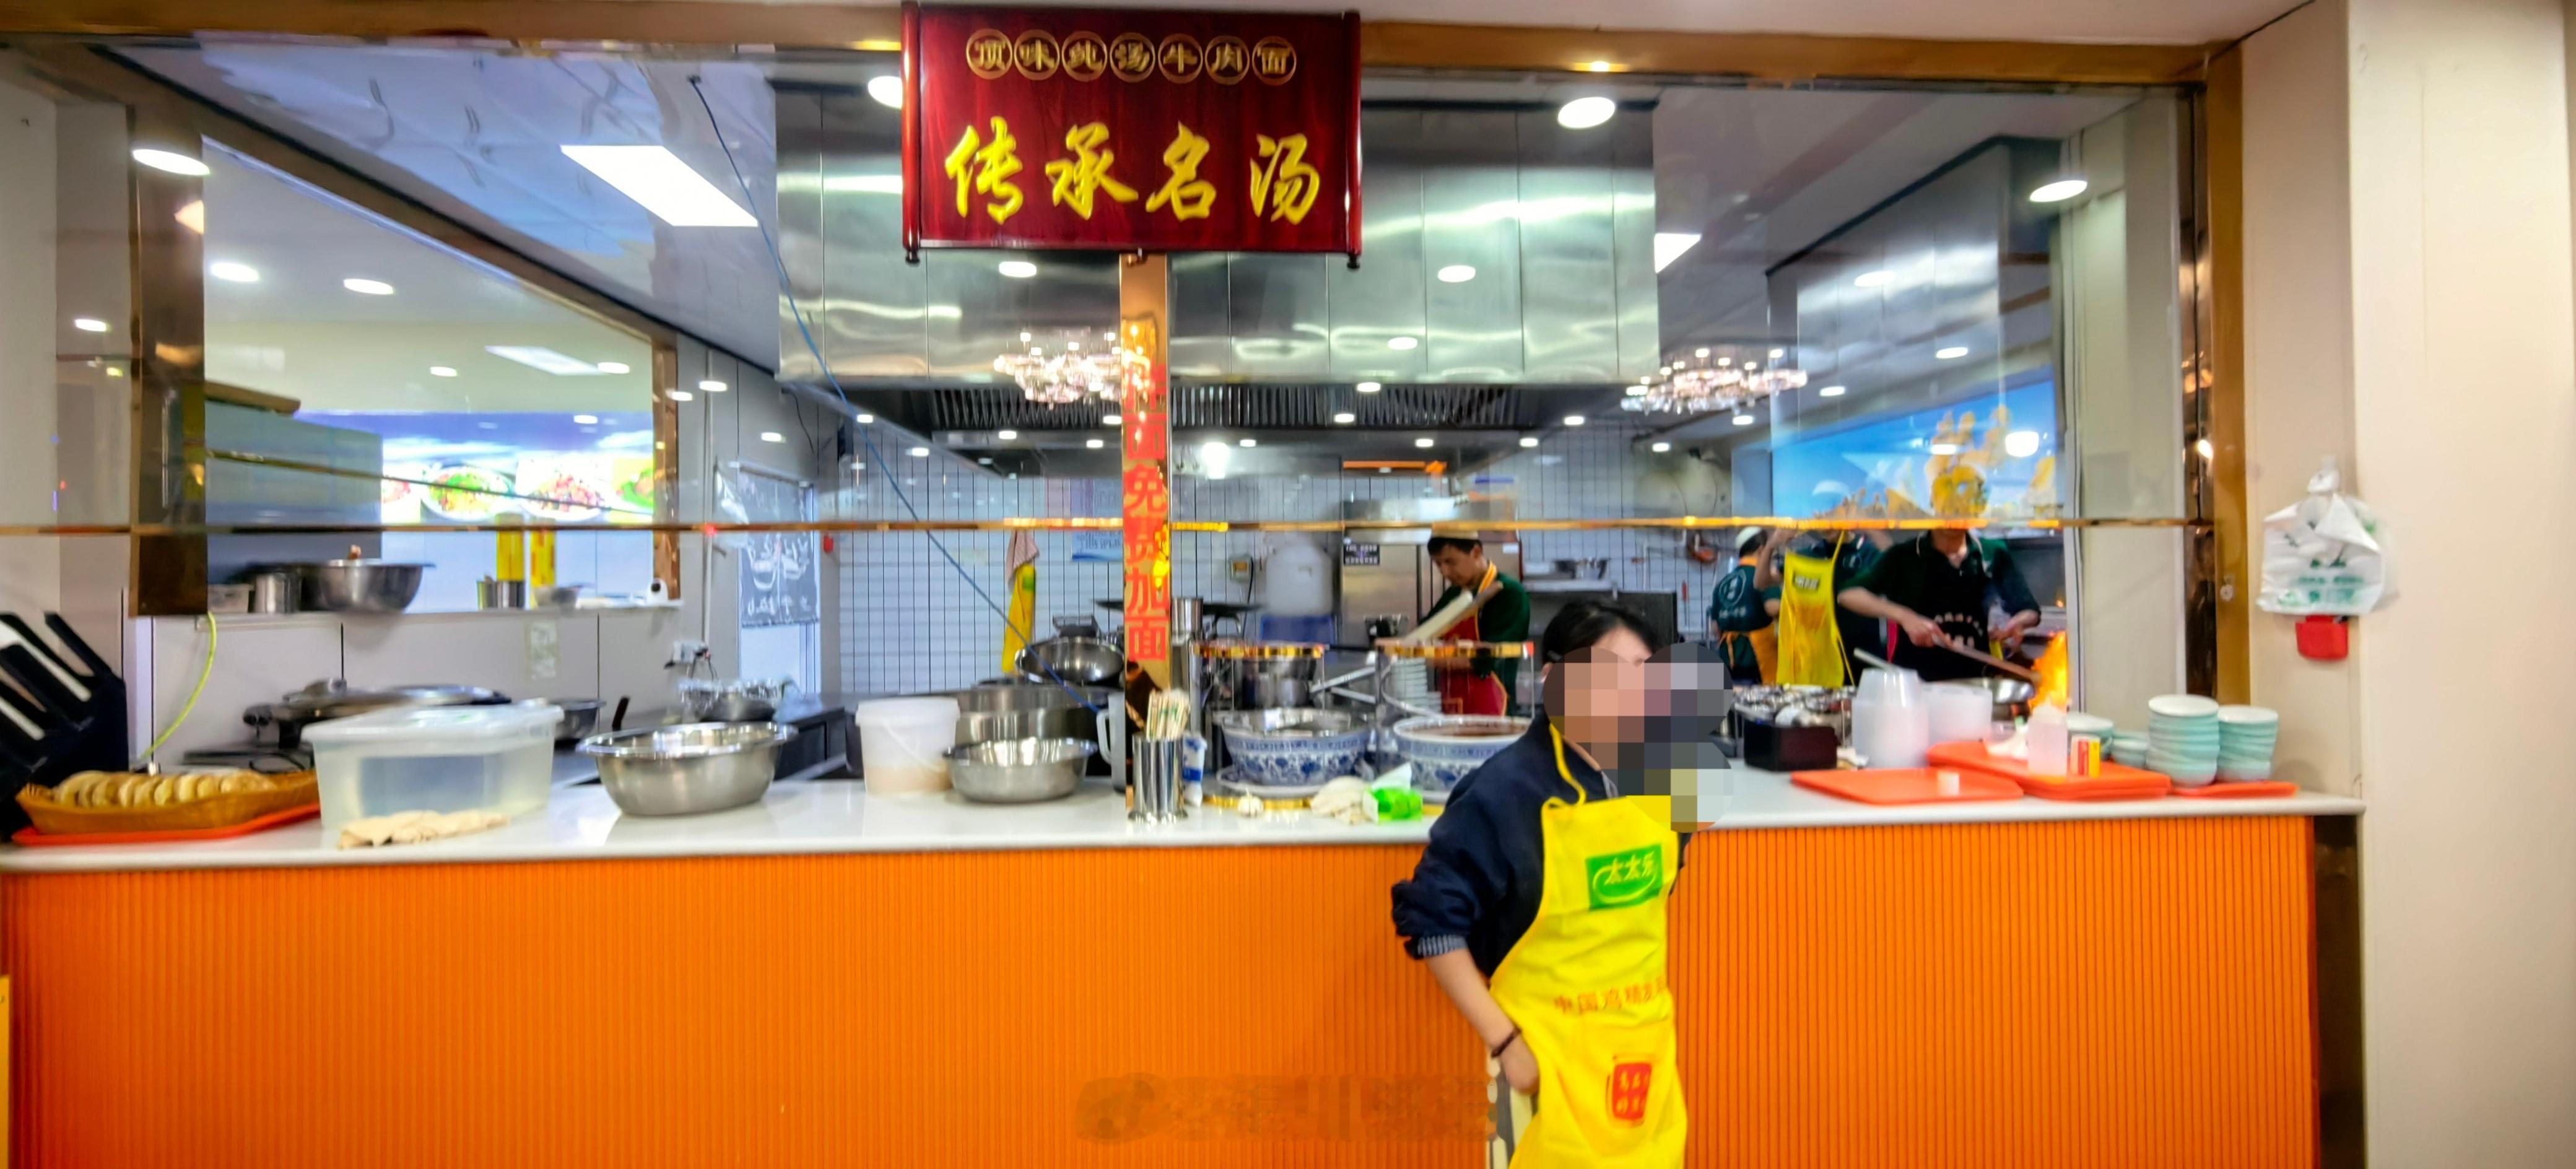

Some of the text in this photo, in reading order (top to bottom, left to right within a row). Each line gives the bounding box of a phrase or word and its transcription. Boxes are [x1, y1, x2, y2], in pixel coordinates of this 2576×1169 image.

[944, 116, 1320, 225] 传承名汤
[1604, 850, 1655, 886] 太太乐
